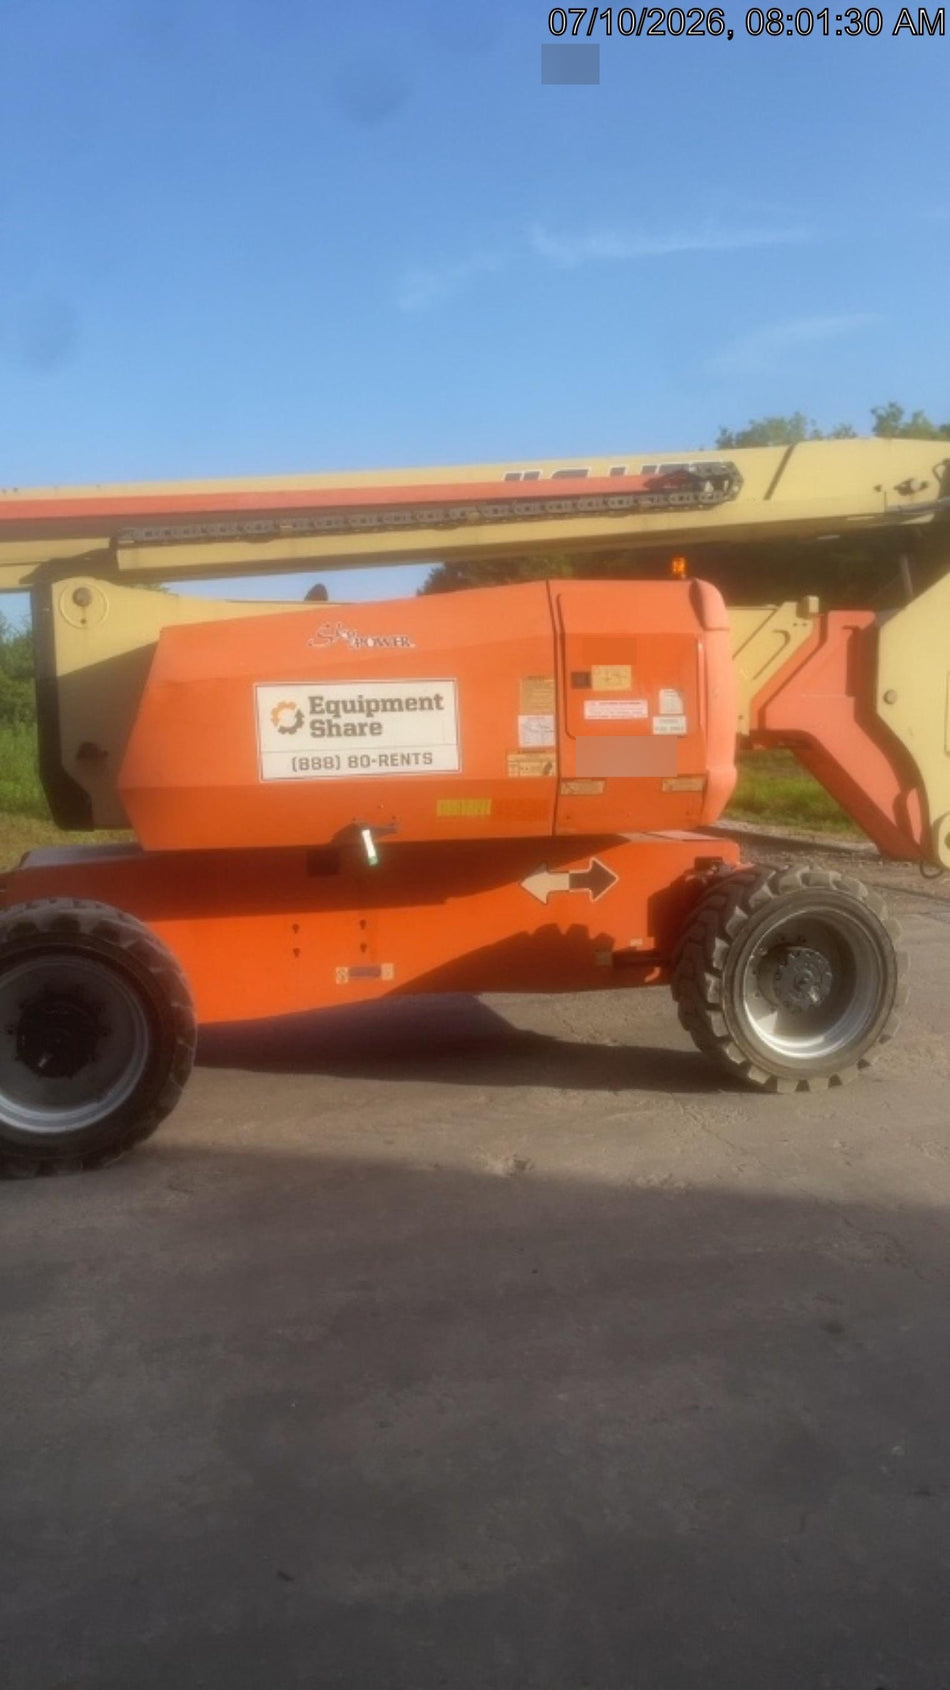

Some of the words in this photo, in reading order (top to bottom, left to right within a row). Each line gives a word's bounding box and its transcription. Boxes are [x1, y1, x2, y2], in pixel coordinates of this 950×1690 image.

[308, 693, 444, 718] Equipment
[310, 719, 384, 739] Share
[292, 755, 341, 772] (888)
[348, 752, 433, 769] 80-RENTS
